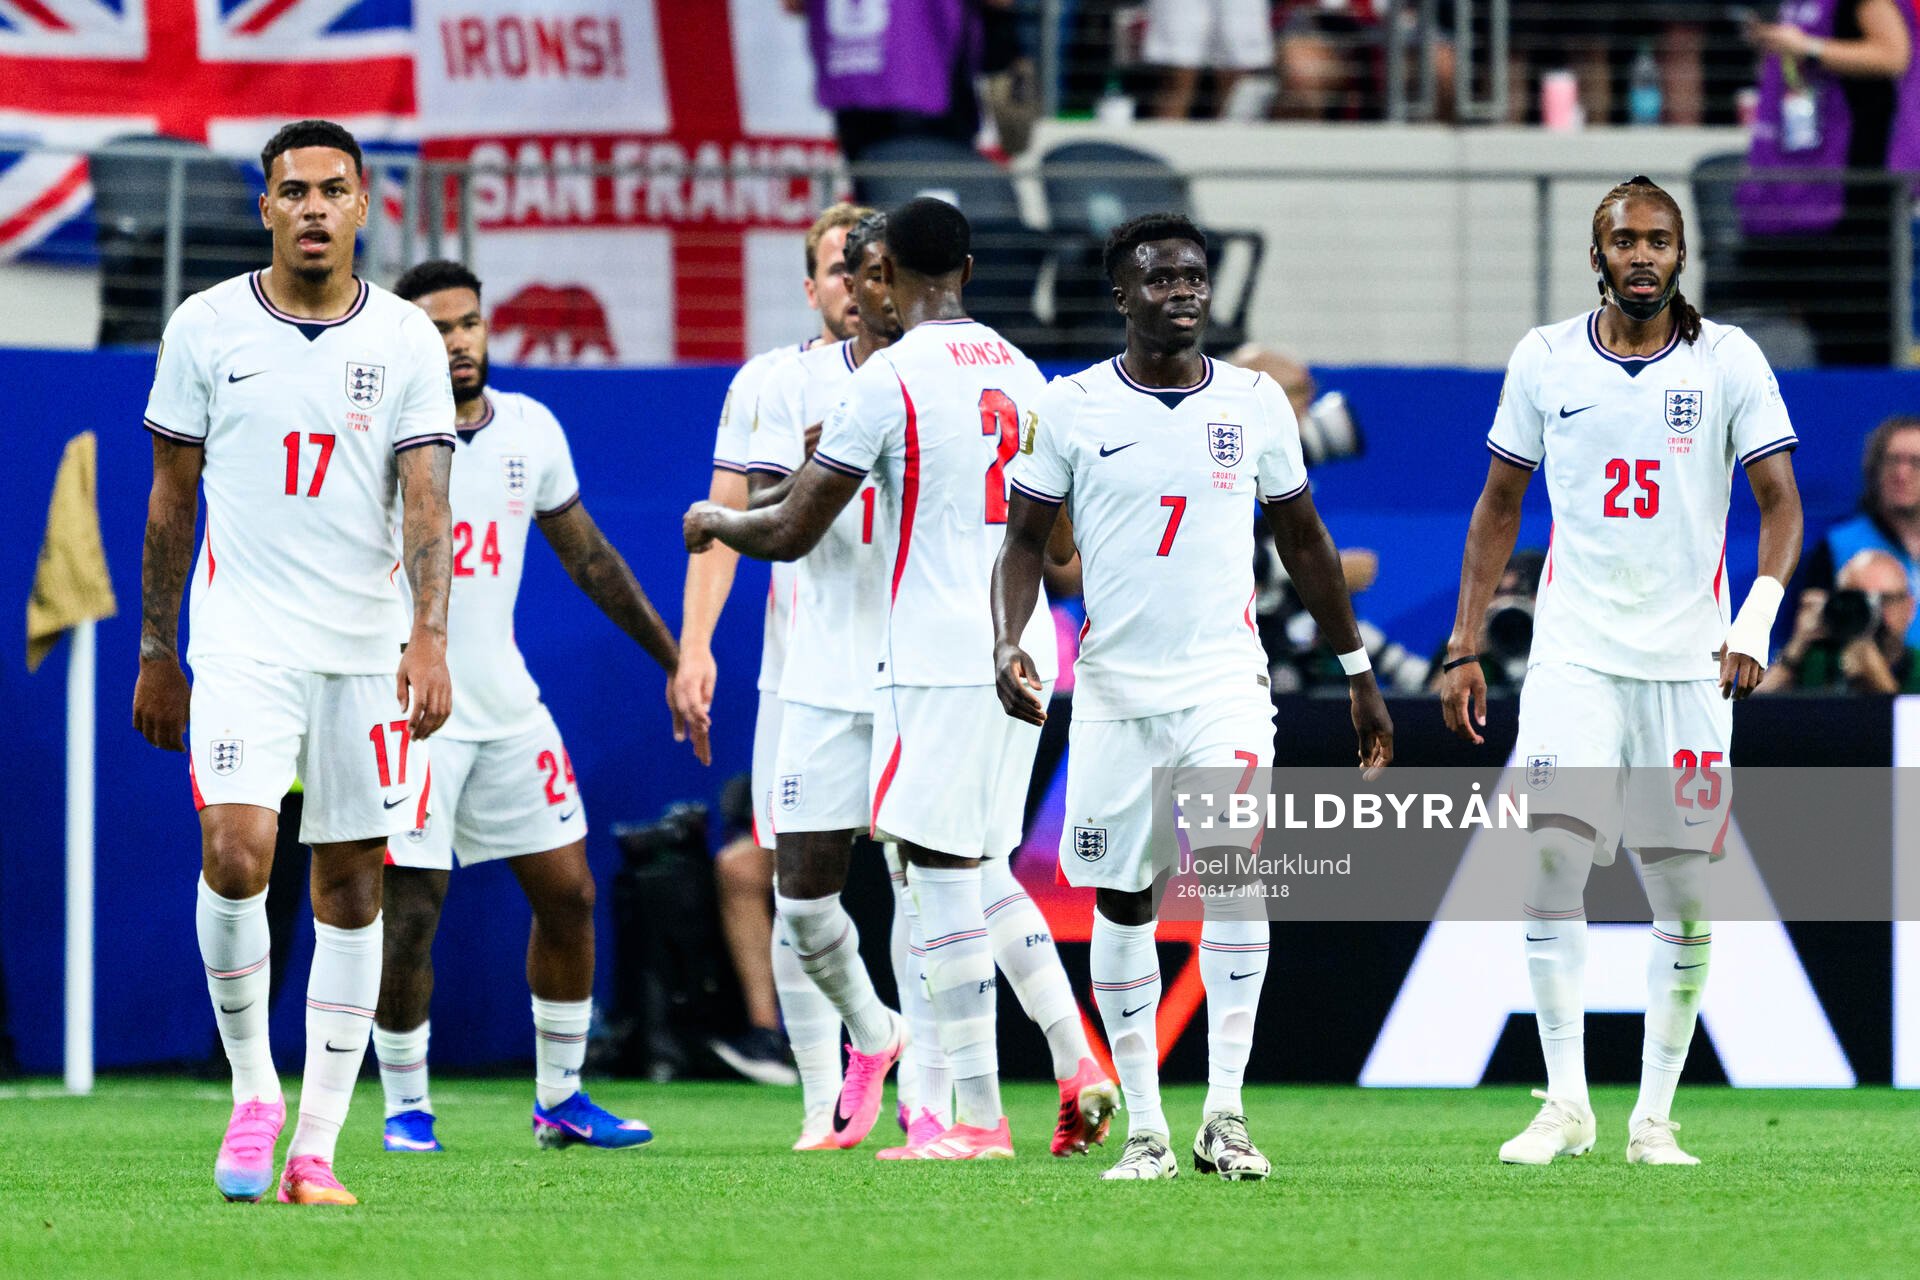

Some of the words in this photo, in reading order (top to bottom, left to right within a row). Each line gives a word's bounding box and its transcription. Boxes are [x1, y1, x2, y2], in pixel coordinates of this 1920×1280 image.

[440, 15, 626, 80] IRONS!
[470, 141, 597, 222] SAN
[945, 341, 1015, 366] KONSA
[283, 431, 336, 498] 17
[978, 388, 1020, 525] 2
[1212, 471, 1237, 481] CROATIA
[1604, 458, 1660, 519] 25
[453, 521, 503, 577] 24
[1157, 495, 1187, 557] 7
[369, 719, 411, 788] 17
[1234, 750, 1259, 808] 7
[1673, 749, 1723, 811] 25
